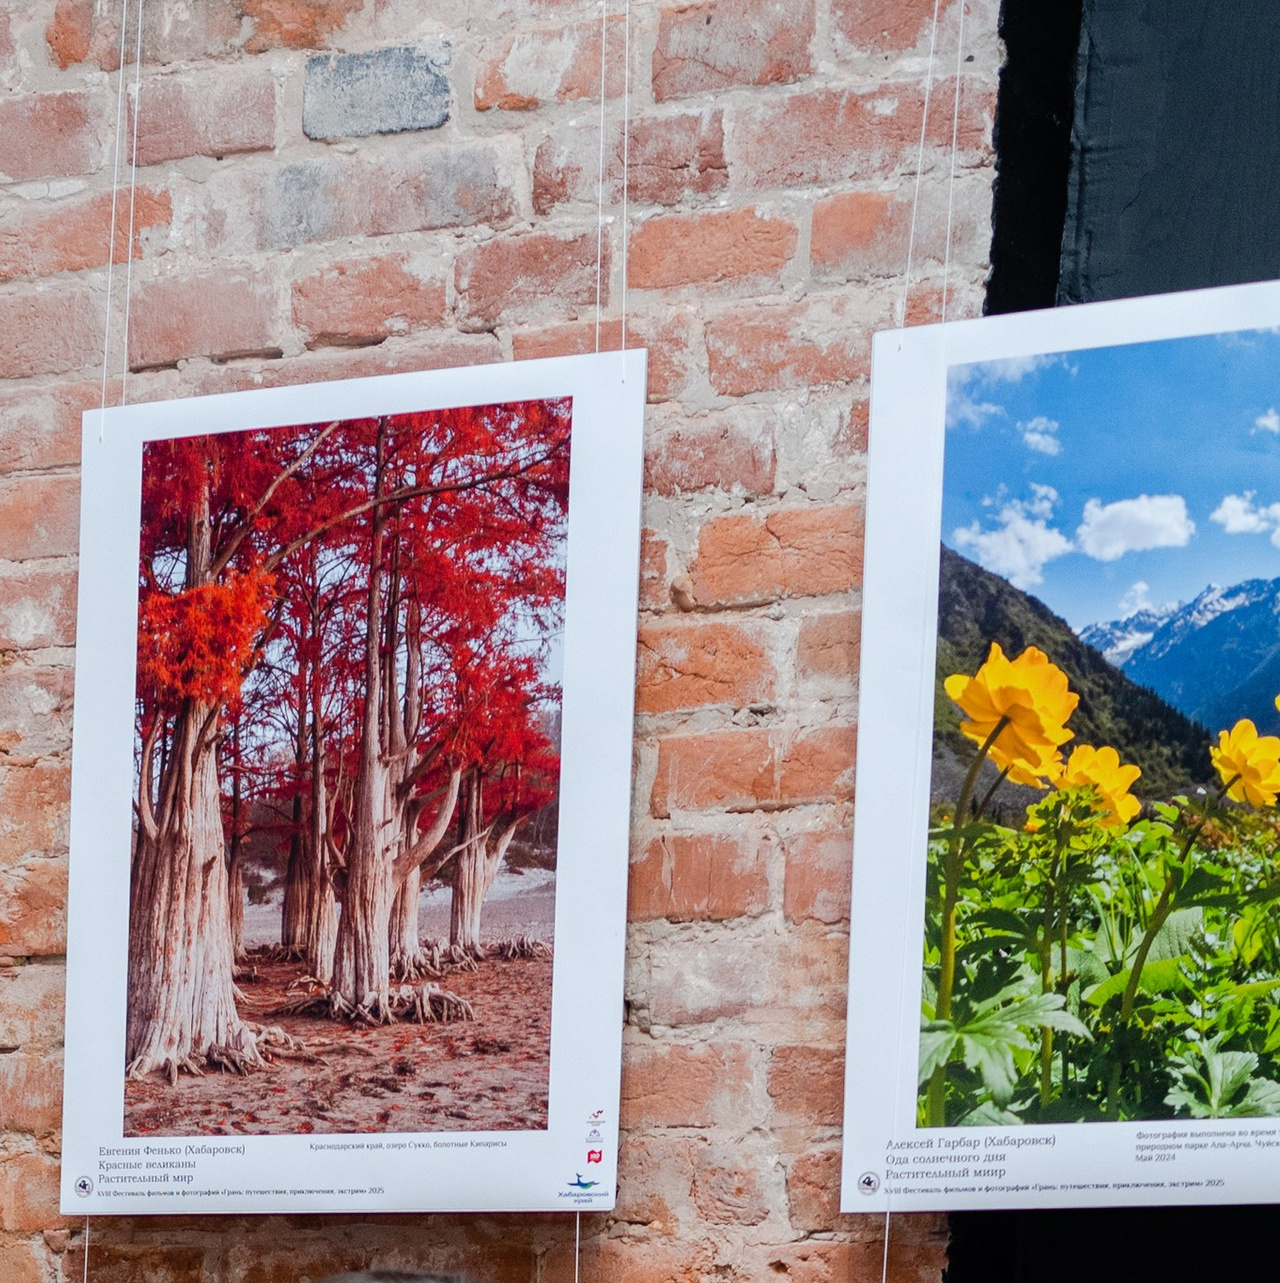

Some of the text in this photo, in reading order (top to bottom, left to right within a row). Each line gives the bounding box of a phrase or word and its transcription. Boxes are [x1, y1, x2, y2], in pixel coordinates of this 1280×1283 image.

[1136, 1131, 1188, 1140] Фотография
[1190, 1130, 1236, 1138] выполнена
[1250, 1129, 1276, 1138] время
[309, 1142, 365, 1152] Краснодарский
[366, 1142, 385, 1150] край,
[434, 1140, 468, 1148] болотные
[470, 1140, 507, 1149] Кипарисы
[886, 1134, 1056, 1151] Алексей Гарбар (Хабаровск)
[1136, 1142, 1182, 1151] природном
[1184, 1142, 1208, 1150] парке
[99, 1144, 246, 1157] Евгения Фенько (Хабаровск)
[886, 1153, 1006, 1166] Ода солнечного дня
[1136, 1153, 1176, 1162] Май 2024
[99, 1160, 196, 1172] Красные великаны
[98, 1172, 194, 1184] Растительный мир
[886, 1168, 1006, 1180] Растительный миир
[902, 1186, 942, 1194] Фестиваль
[944, 1186, 976, 1194] фильмов
[984, 1184, 1029, 1193] фотографий
[1205, 1179, 1225, 1187] 2025
[181, 1189, 220, 1197] фотографий
